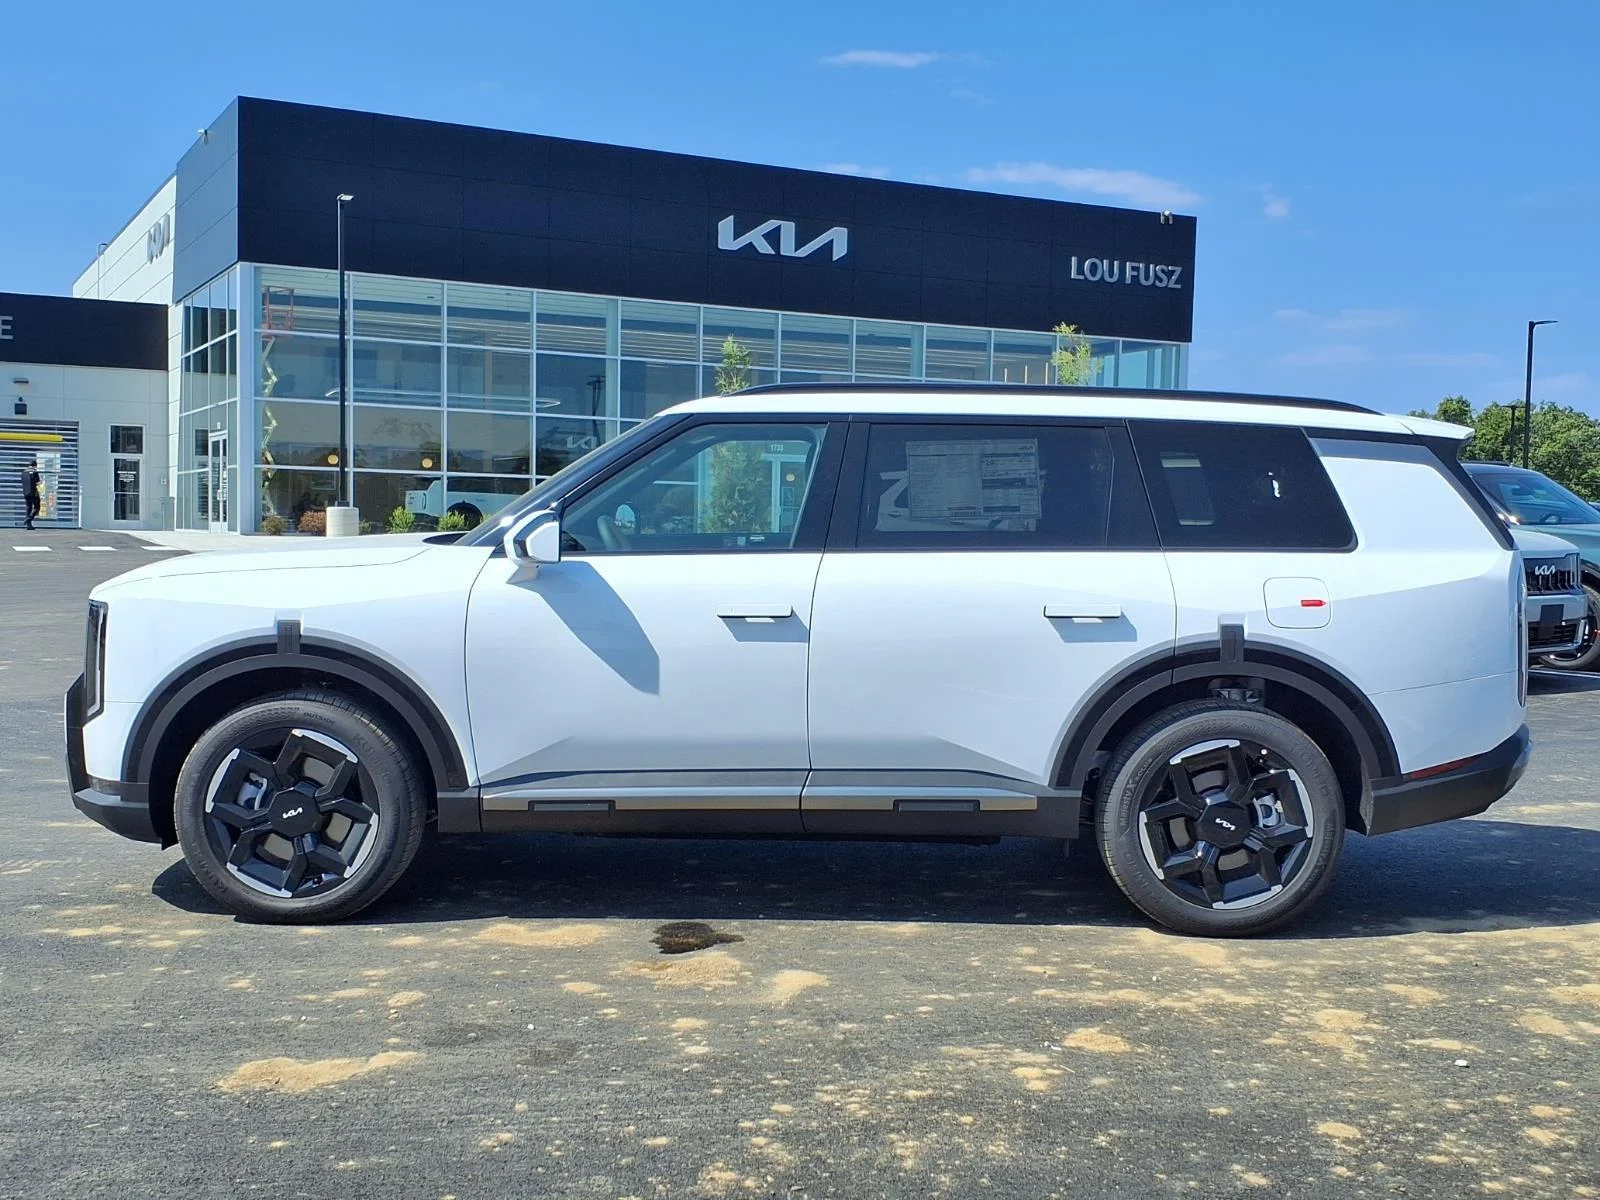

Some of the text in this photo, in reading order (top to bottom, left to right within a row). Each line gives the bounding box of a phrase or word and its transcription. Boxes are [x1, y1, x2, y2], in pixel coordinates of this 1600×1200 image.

[718, 215, 848, 261] KIA
[1071, 256, 1183, 289] LOU FUSZ
[1534, 565, 1556, 575] KIA
[282, 807, 303, 819] KIA
[1215, 817, 1236, 831] KIA
